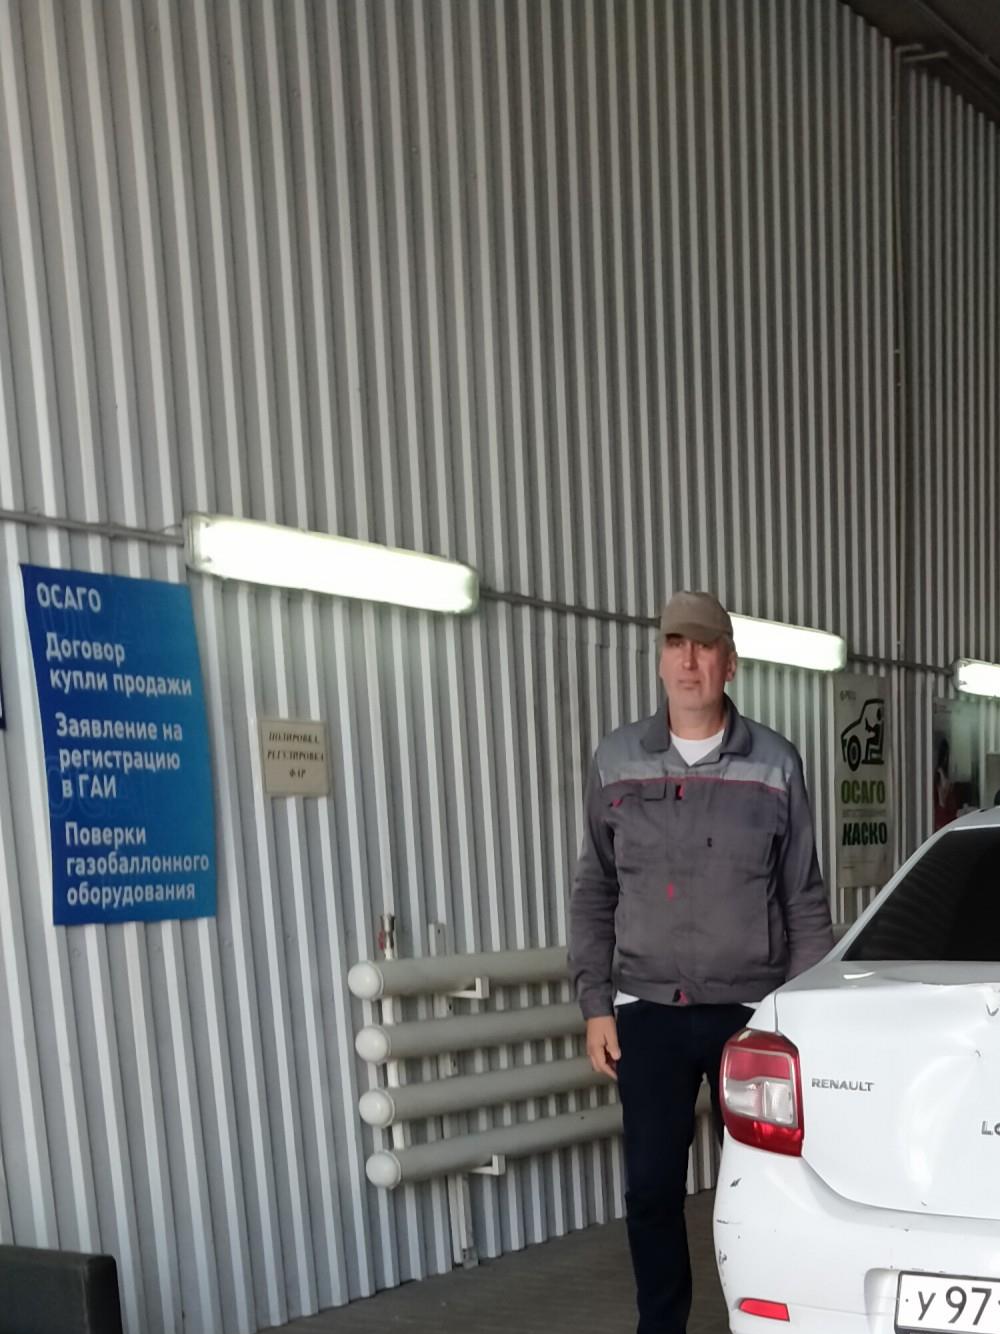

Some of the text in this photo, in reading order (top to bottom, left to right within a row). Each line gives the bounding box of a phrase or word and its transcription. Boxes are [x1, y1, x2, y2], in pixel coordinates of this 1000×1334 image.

[36, 581, 102, 613] ОСАГО
[46, 632, 126, 668] Договор
[50, 668, 192, 698] купли продажи
[55, 712, 183, 741] Заявление на
[59, 748, 181, 774] регистрацию
[61, 774, 117, 799] в ГАИ
[841, 780, 886, 804] ОСАГО
[65, 821, 147, 849] Поверки
[842, 822, 888, 846] КАСКО
[66, 851, 209, 876] газобаллонного
[67, 881, 196, 909] оборудования
[811, 1078, 875, 1091] RENAULT
